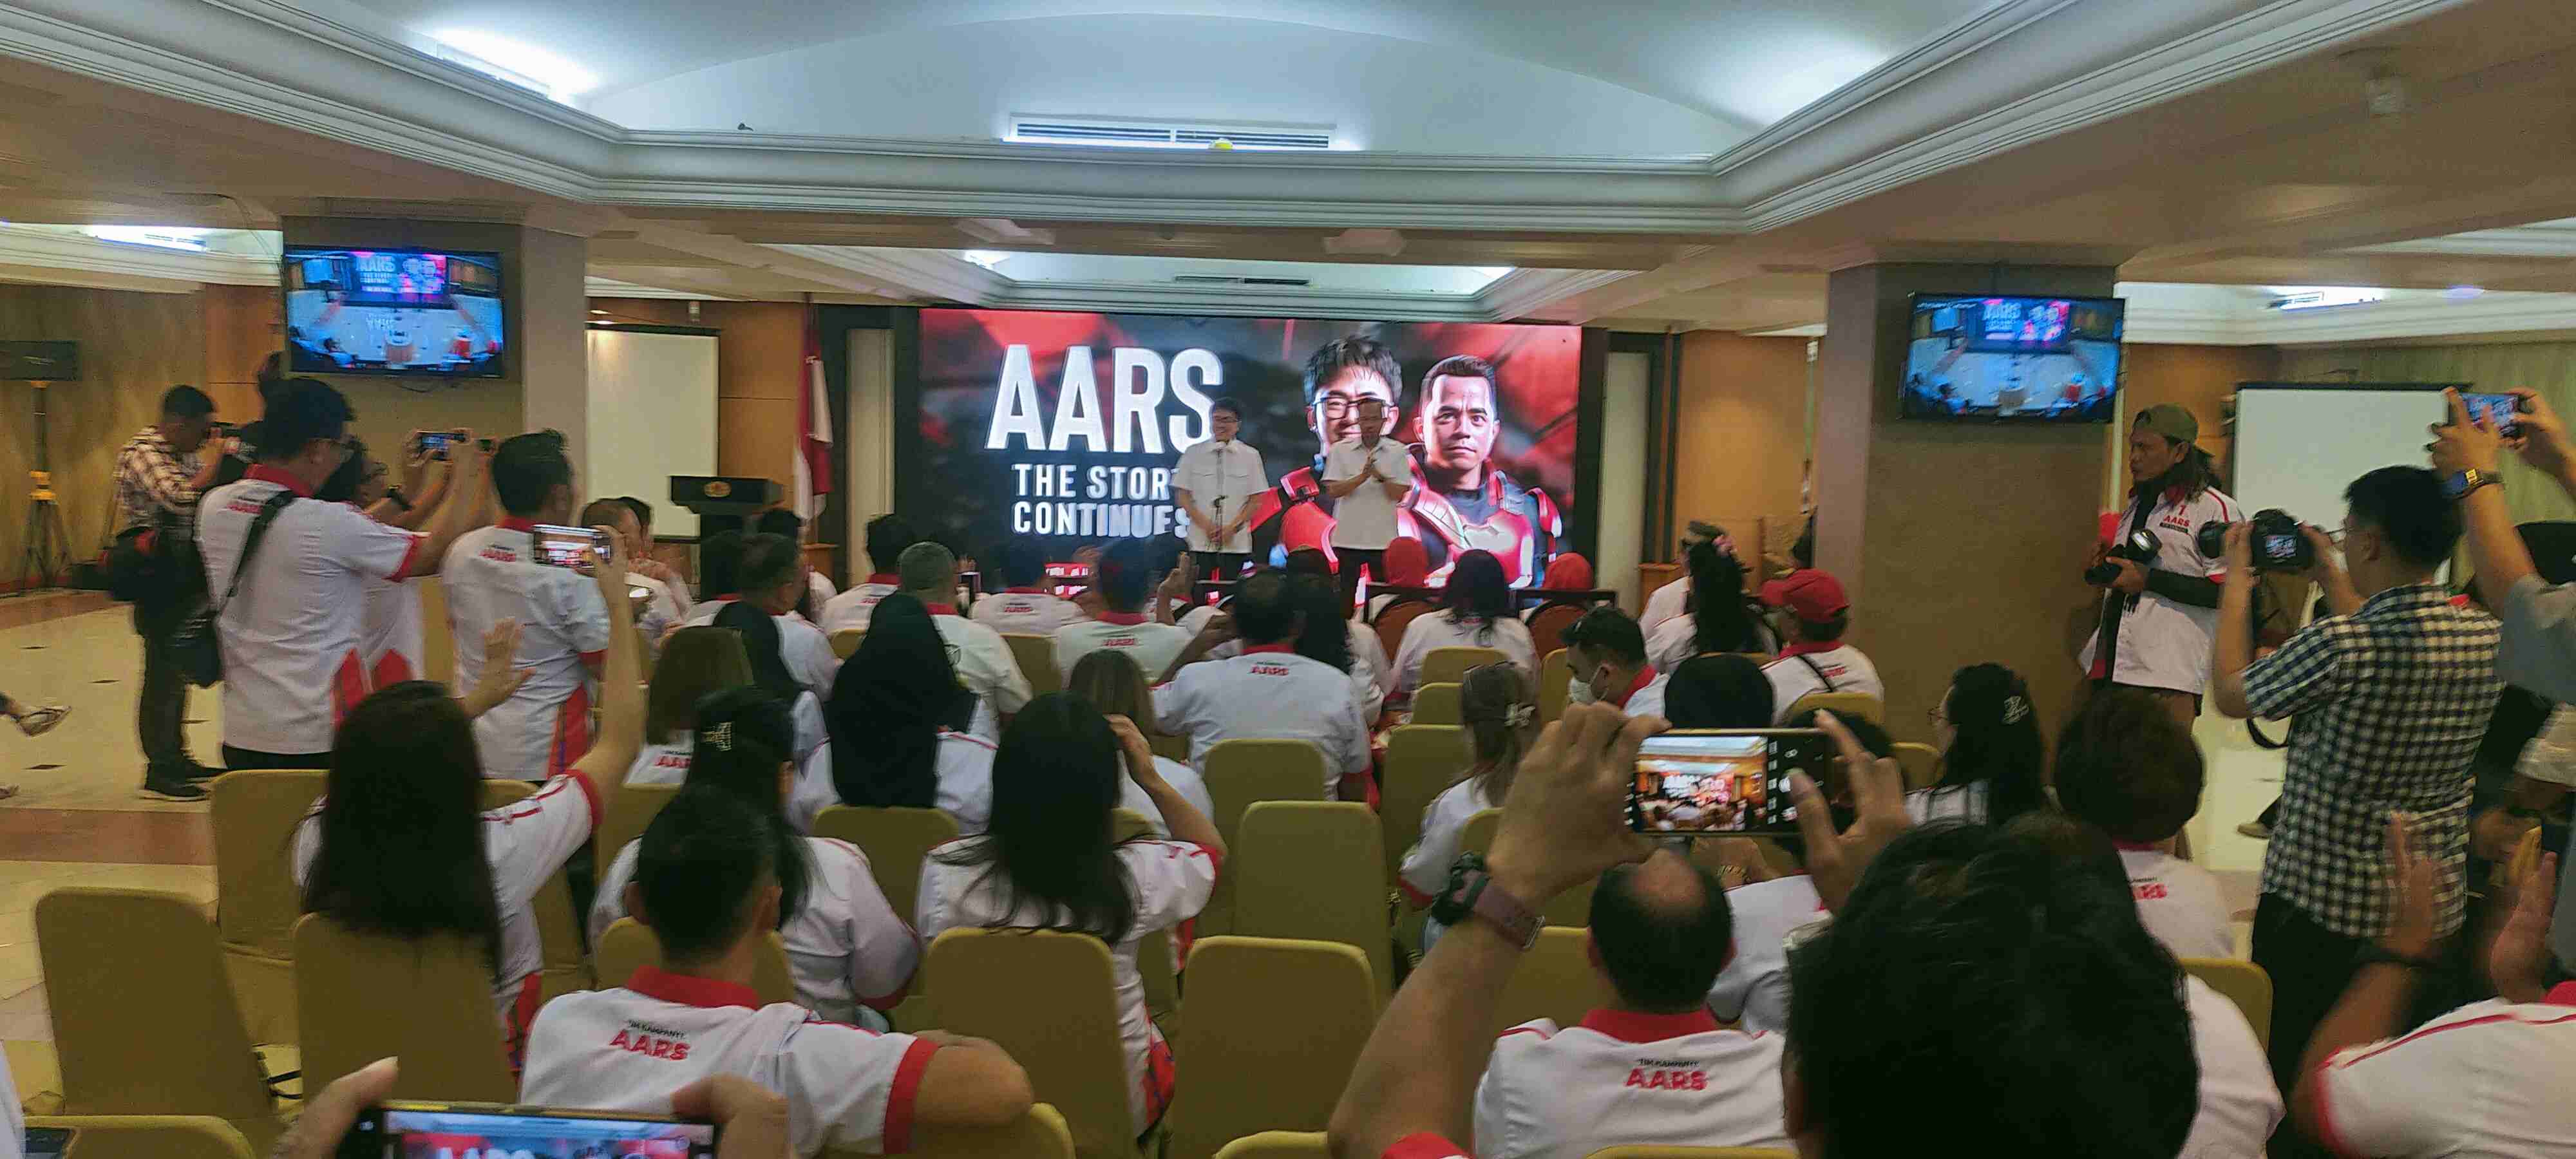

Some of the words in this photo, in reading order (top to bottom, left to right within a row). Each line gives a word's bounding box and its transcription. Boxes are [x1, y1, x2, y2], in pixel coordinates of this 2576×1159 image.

[985, 344, 1222, 453] AARS
[1011, 464, 1076, 498] THE
[1086, 466, 1179, 500] STOR
[1012, 501, 1190, 538] CONTINUES
[2164, 515, 2190, 527] AARS
[609, 1030, 690, 1060] AARS
[1625, 1068, 1709, 1091] AARS
